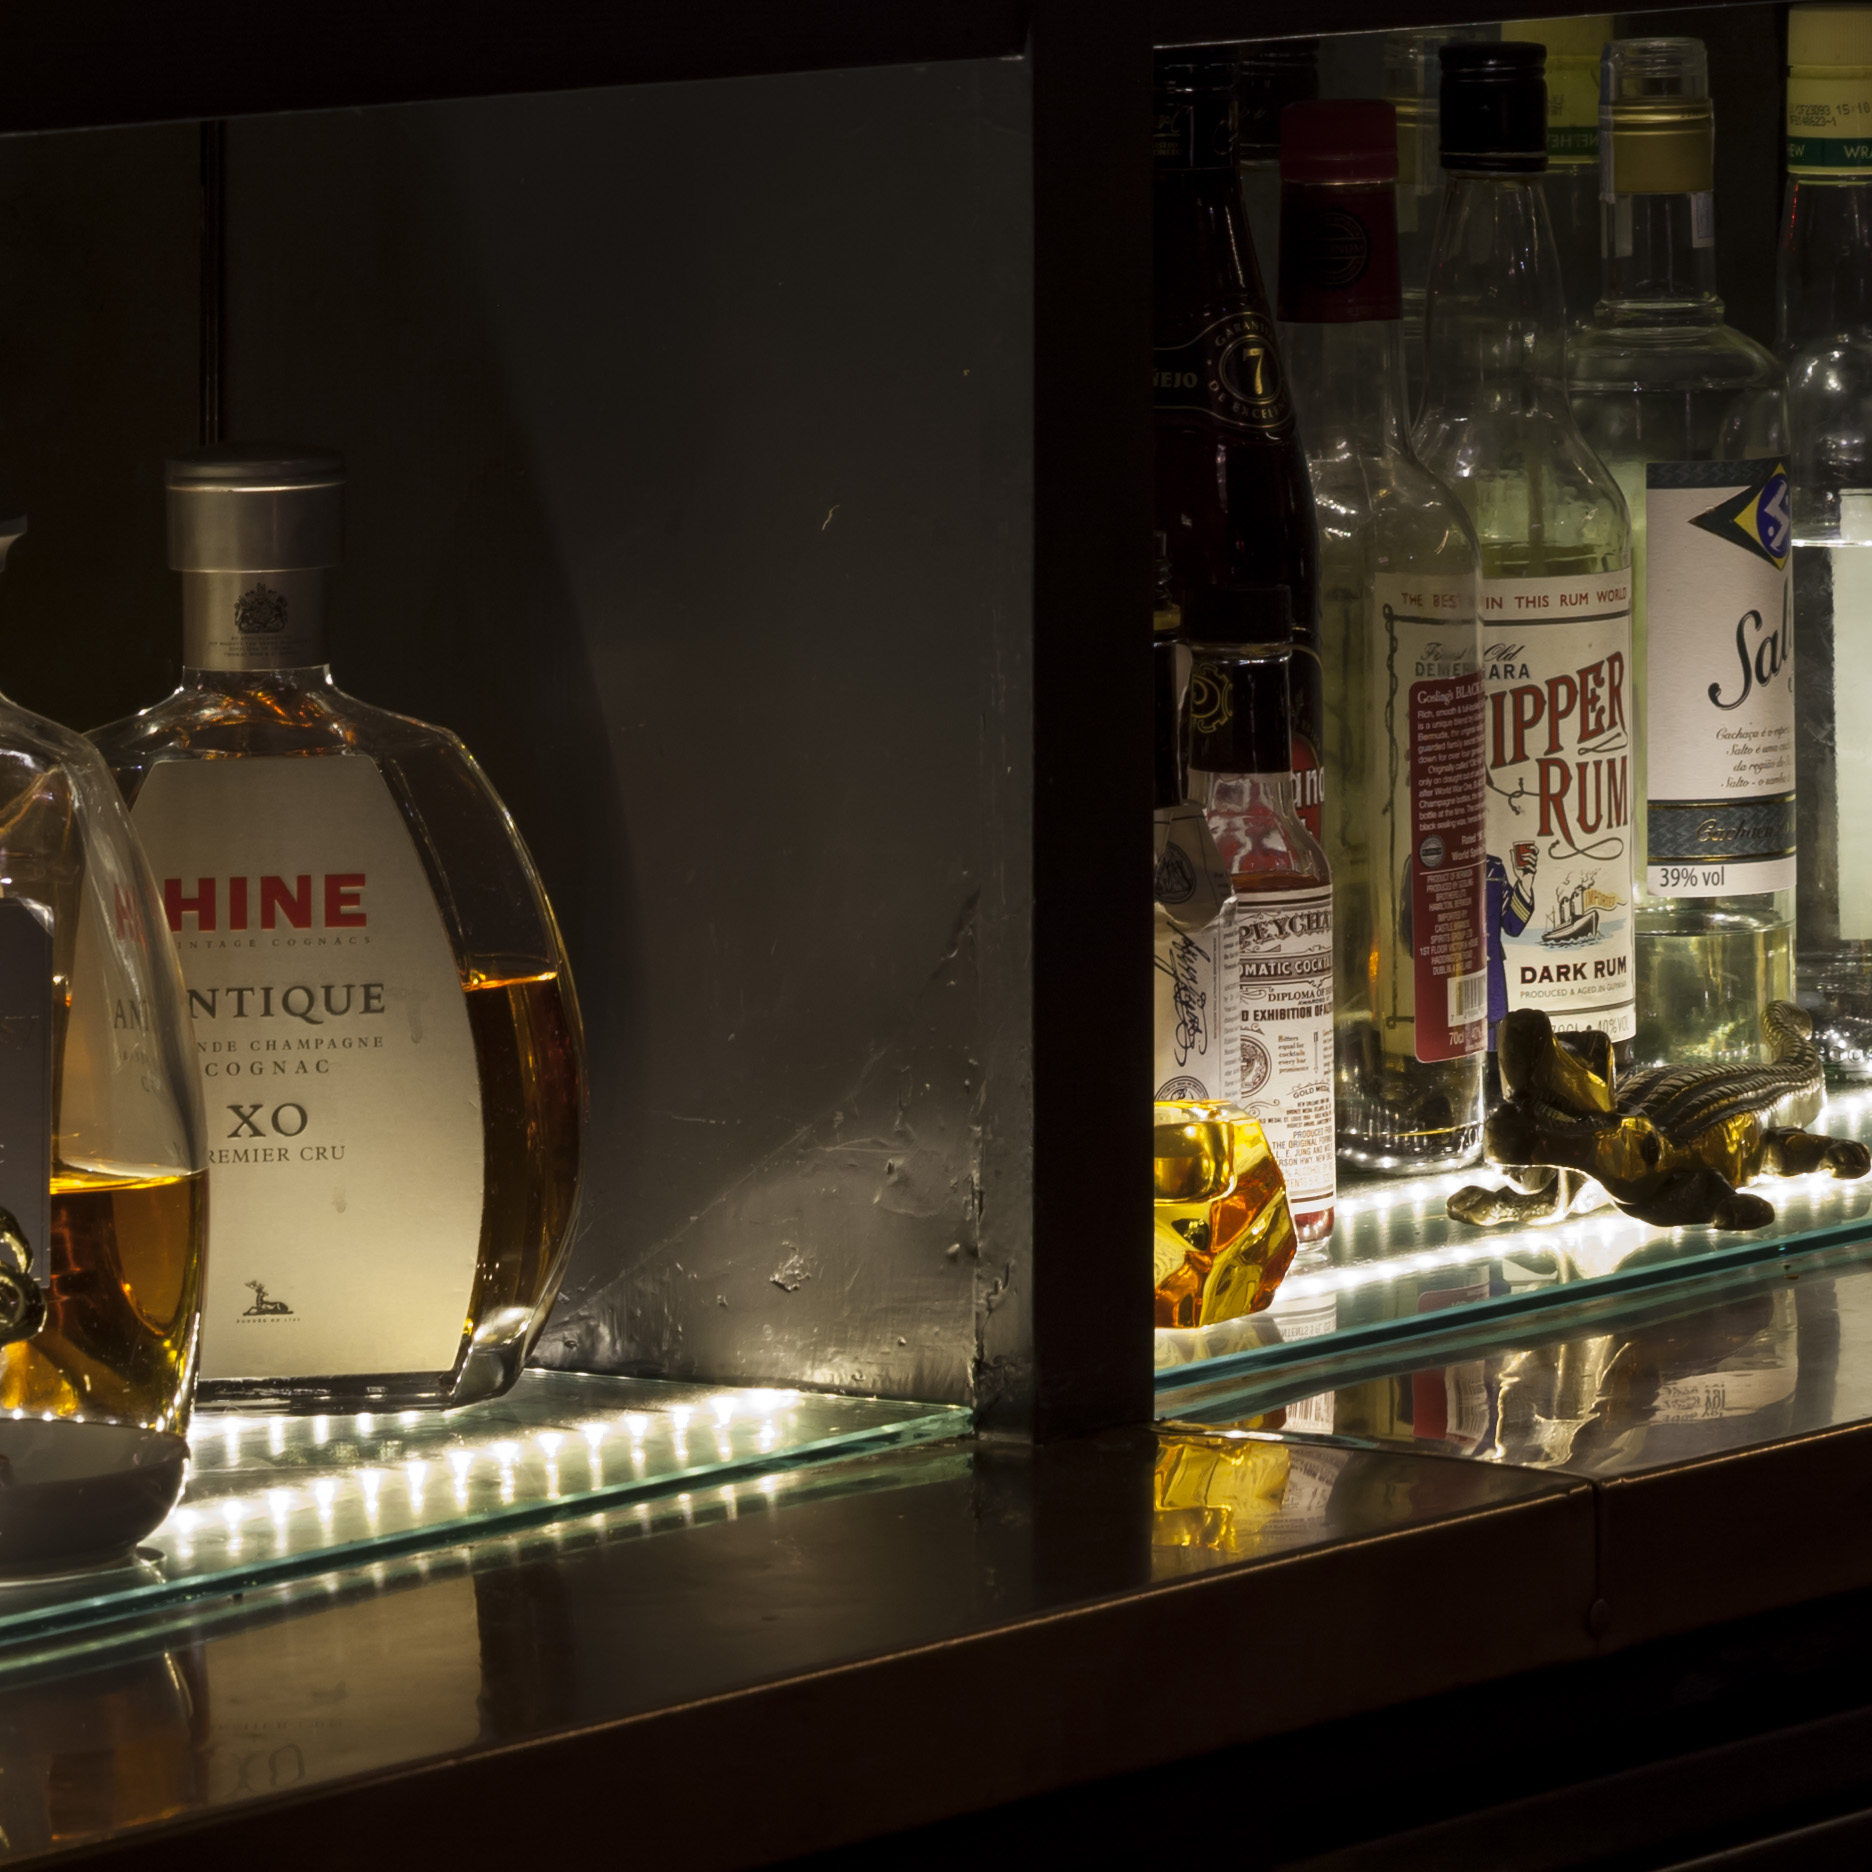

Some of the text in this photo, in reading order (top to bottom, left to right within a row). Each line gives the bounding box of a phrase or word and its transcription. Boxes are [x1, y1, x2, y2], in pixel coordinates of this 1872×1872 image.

[1242, 347, 1265, 395] 7
[1402, 586, 1628, 609] THE THIS RUM WORLD
[1483, 642, 1526, 663] Old
[1417, 688, 1454, 706] Gosling's
[1485, 650, 1629, 771] IPPER
[1716, 726, 1760, 742] Cachaça
[1726, 743, 1754, 757] Salto
[1720, 776, 1750, 789] Salto
[1535, 755, 1629, 846] RUM
[1659, 865, 1725, 888] 39% vol
[164, 872, 367, 933] HINE
[271, 936, 371, 947] COGNACS
[1520, 955, 1628, 985] DARK RUM
[1268, 988, 1318, 1003] DIPLOMA
[1520, 988, 1568, 999] PRODUCED
[186, 983, 386, 1026] NTIQUE
[1253, 1005, 1312, 1023] EXHIBITION
[250, 1036, 385, 1052] CHAMPAGNE
[204, 1058, 330, 1078] COGNAC
[226, 1102, 309, 1139] XO
[300, 1144, 346, 1161] CRU
